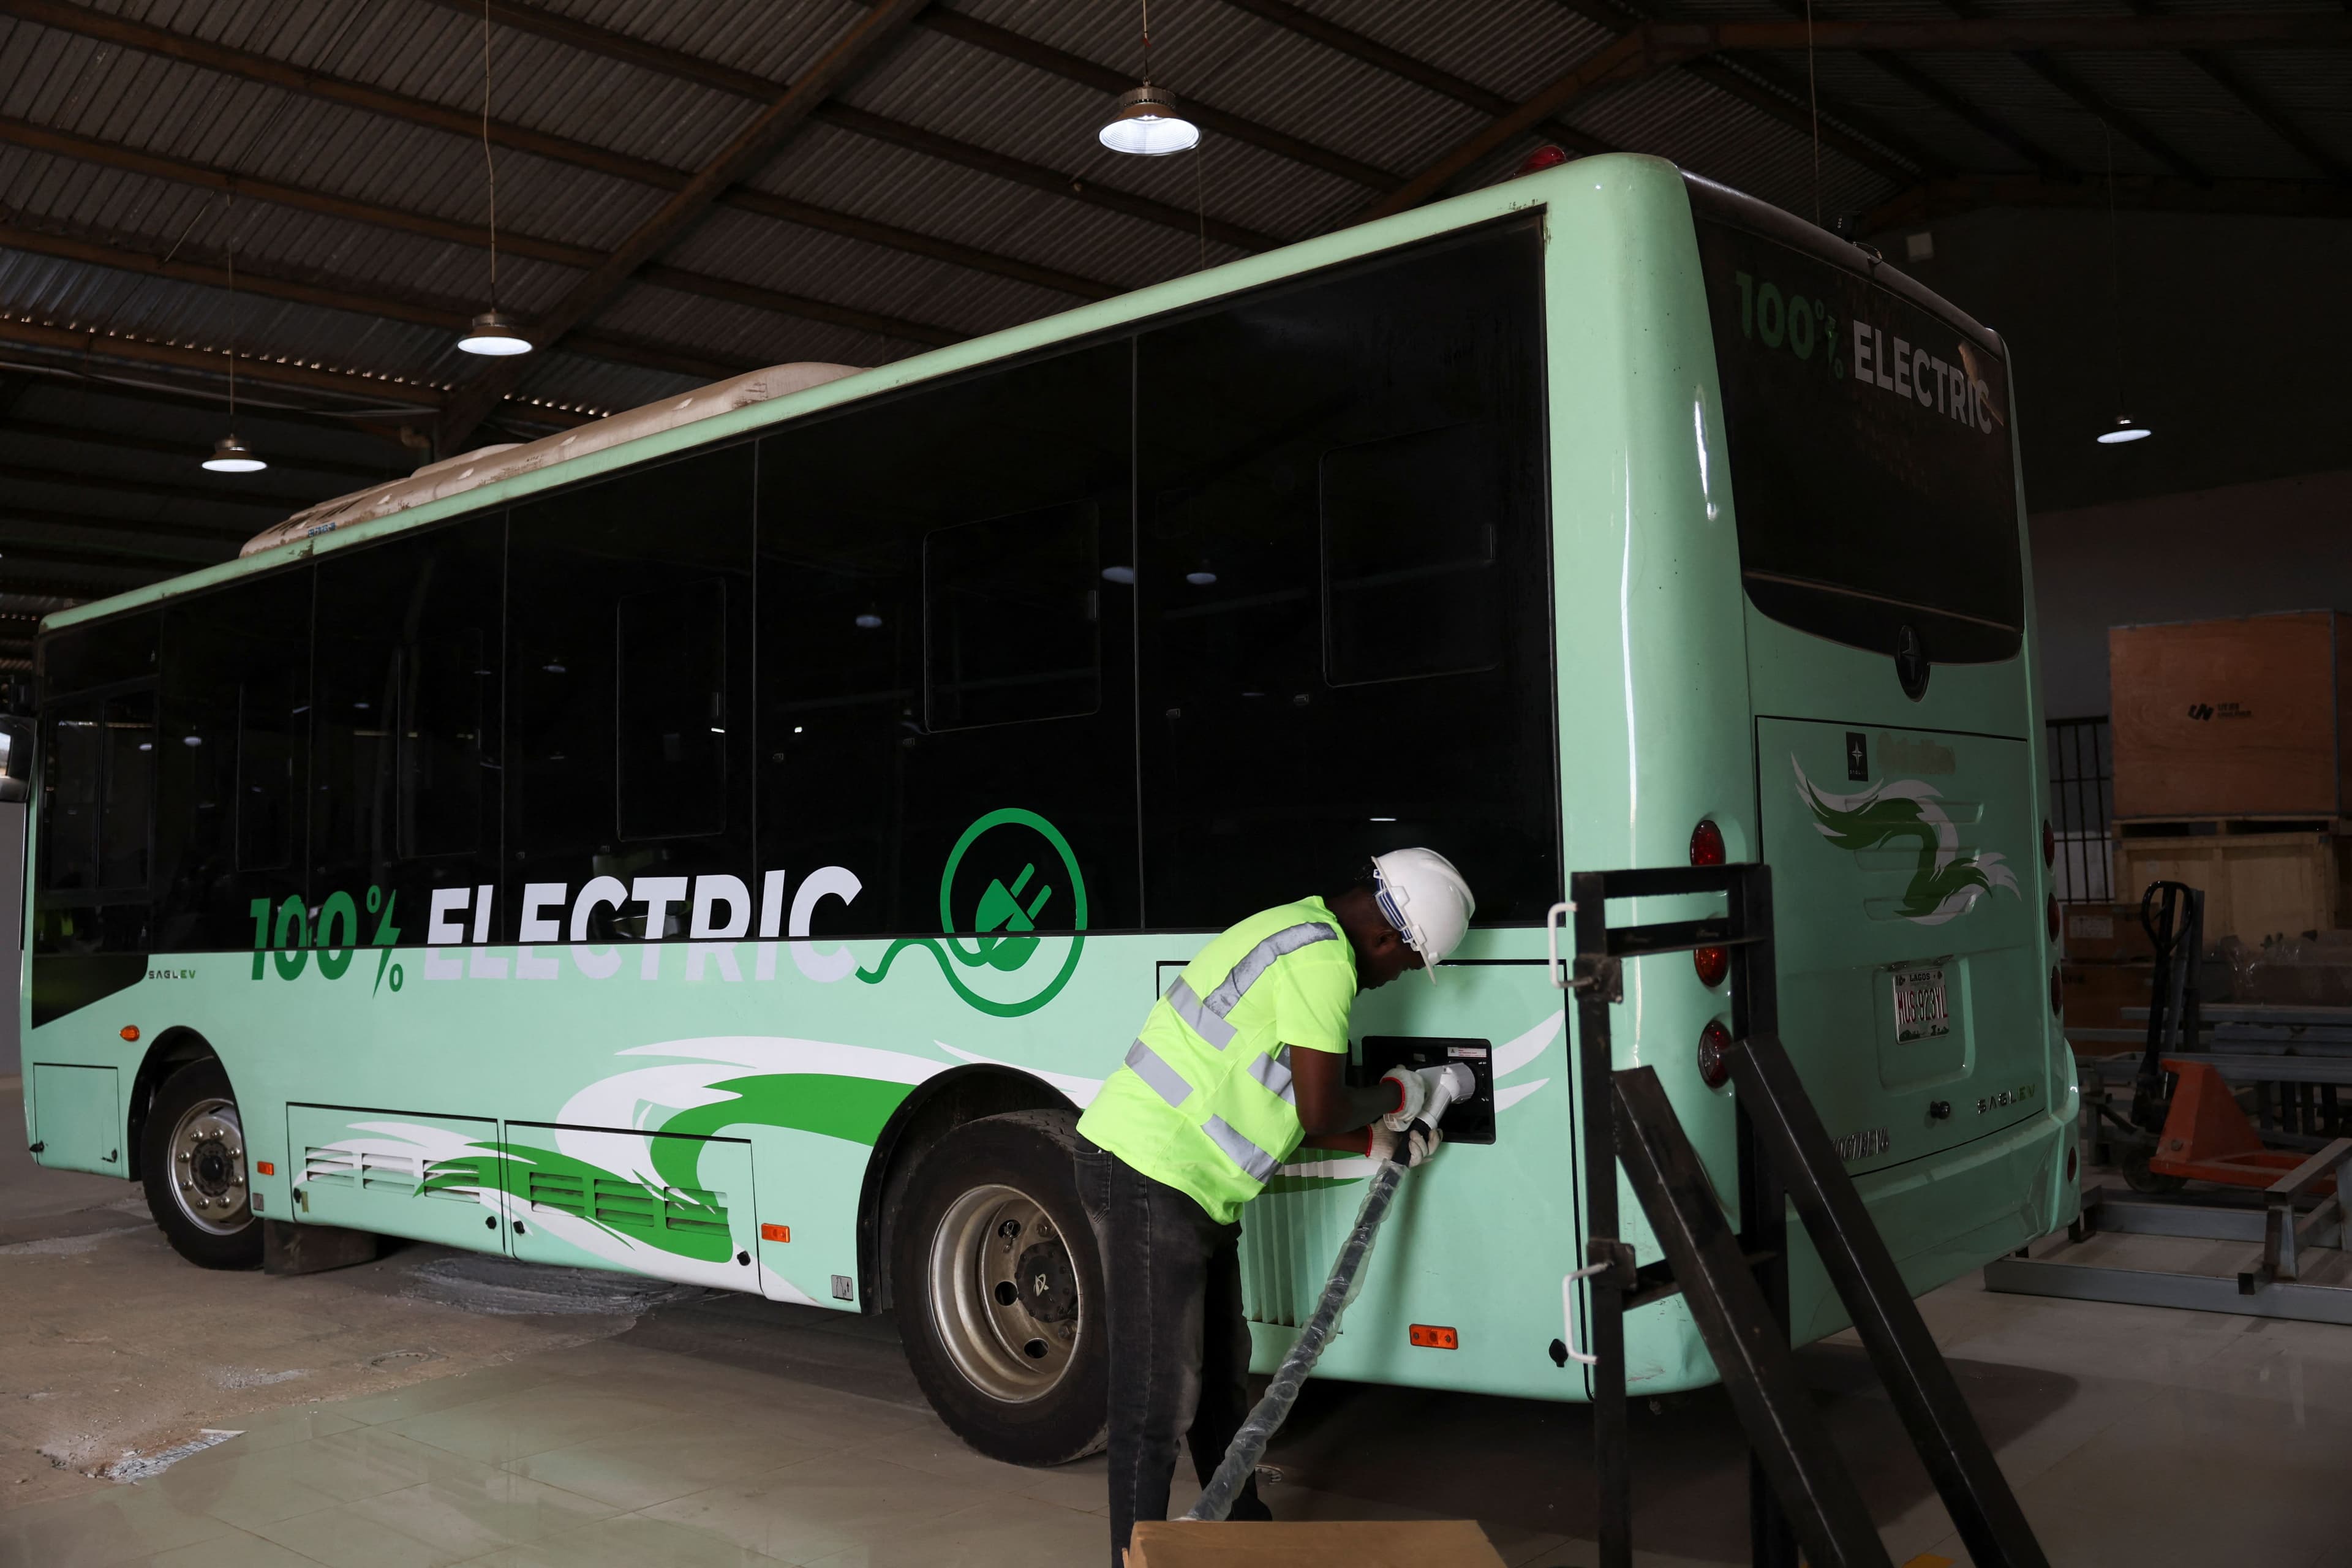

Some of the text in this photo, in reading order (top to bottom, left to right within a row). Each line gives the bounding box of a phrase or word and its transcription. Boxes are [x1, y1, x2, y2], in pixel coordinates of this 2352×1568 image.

[1736, 271, 1992, 434] 100% ELECTRIC
[250, 866, 862, 999] 100% ELECTRIC
[148, 970, 195, 979] SAGLEV
[1977, 1084, 2035, 1115] SAGLEV
